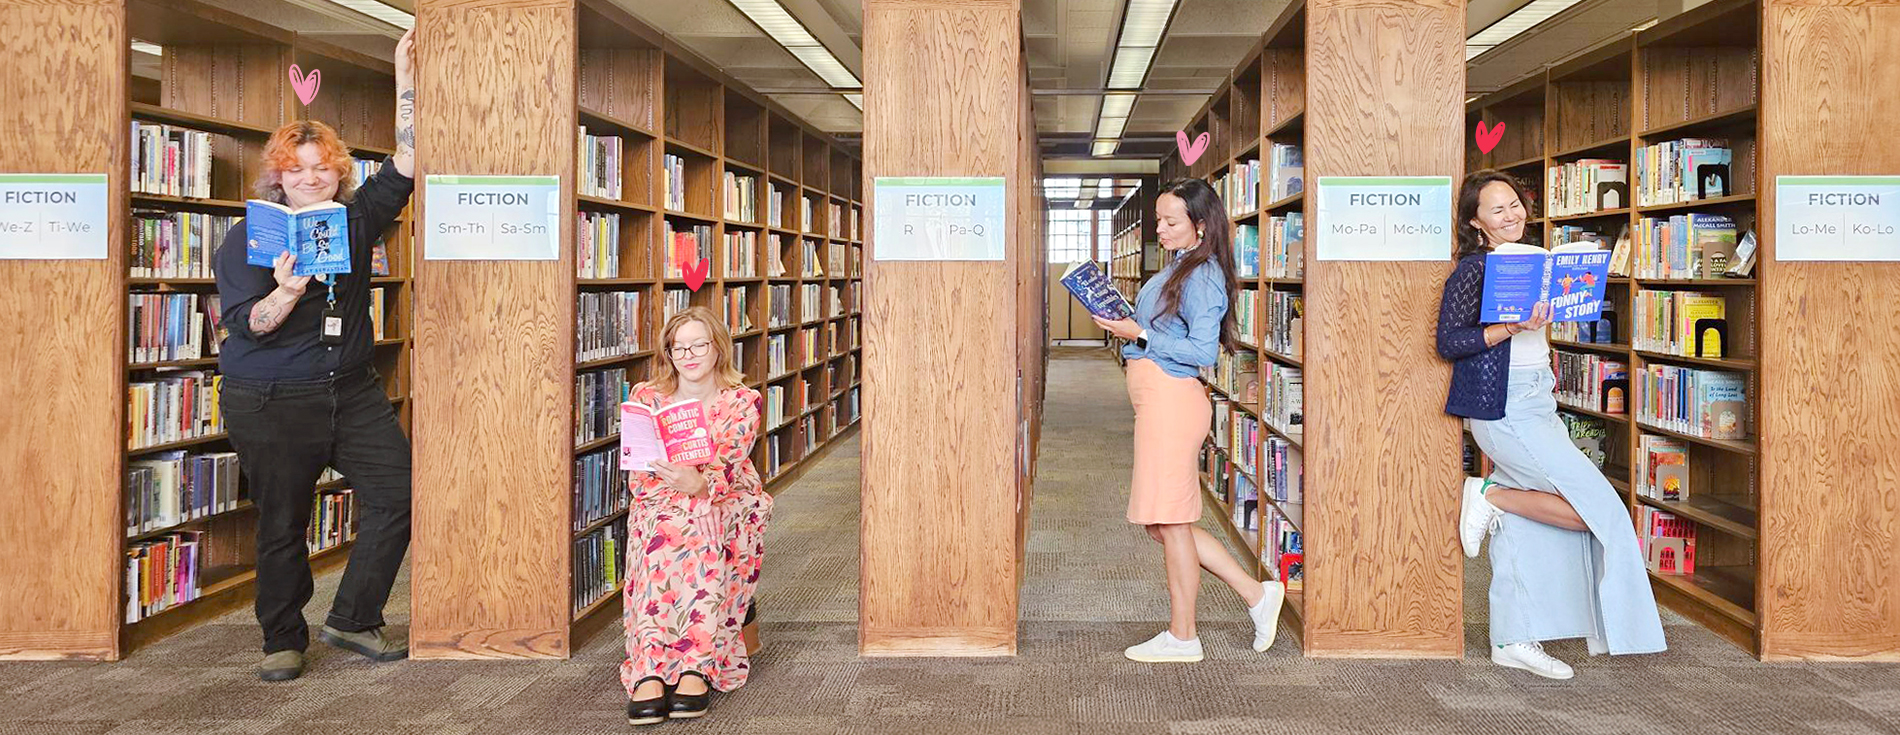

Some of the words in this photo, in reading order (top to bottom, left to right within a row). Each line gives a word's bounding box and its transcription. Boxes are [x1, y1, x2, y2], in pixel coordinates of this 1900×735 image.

[5, 191, 77, 204] FICTION
[458, 193, 529, 205] FICTION
[905, 194, 976, 207] FICTION
[1350, 193, 1421, 206] FICTION
[1808, 193, 1880, 206] FICTION
[48, 221, 91, 233] Ti-We
[303, 216, 321, 230] We
[438, 222, 485, 234] Sm-Th
[500, 222, 547, 234] Sa-Sm
[1332, 223, 1377, 235] Mo-Pa
[1393, 223, 1442, 235] Mc-Mo
[1792, 223, 1837, 235] Lo-Me
[1852, 223, 1895, 235] Ko-Lo
[310, 224, 339, 240] Could
[904, 224, 914, 235] R
[949, 224, 985, 237] Pa-Q
[318, 248, 345, 263] Good
[1556, 255, 1580, 266] EMILY
[1582, 254, 1608, 265] HENRY
[1550, 290, 1587, 309] FUNNY
[1564, 300, 1601, 319] STORY
[661, 408, 700, 427] ROMANTIC
[668, 418, 698, 435] COMEDY
[682, 438, 709, 451] CURTIS
[671, 447, 711, 463] SITTENFELD
